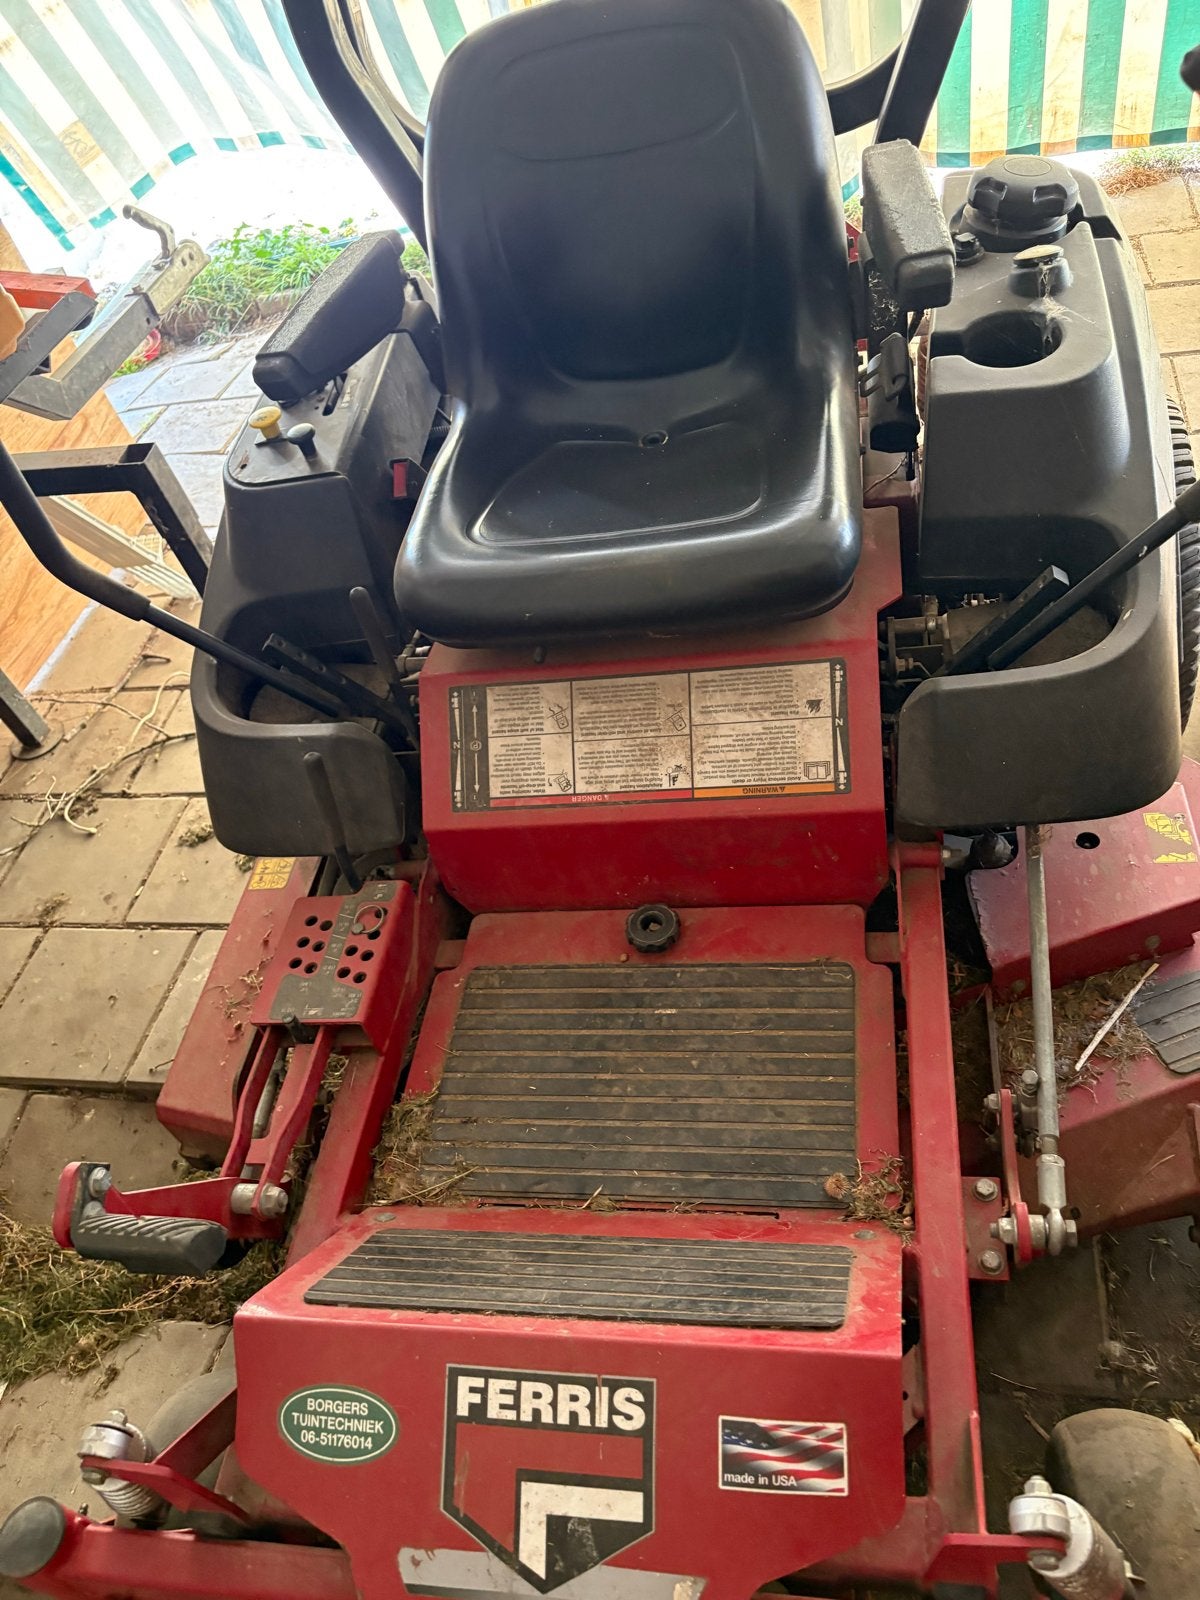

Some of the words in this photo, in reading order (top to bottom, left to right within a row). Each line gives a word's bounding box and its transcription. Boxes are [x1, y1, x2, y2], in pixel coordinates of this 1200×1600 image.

[835, 718, 843, 726] N
[307, 1398, 368, 1416] BORGERS
[456, 1376, 646, 1431] FERRIS
[291, 1412, 384, 1434] TUINTECHNIEK
[301, 1430, 373, 1450] 06-51176014
[724, 1472, 755, 1484] made
[758, 1474, 768, 1485] in
[772, 1475, 798, 1487] USA
